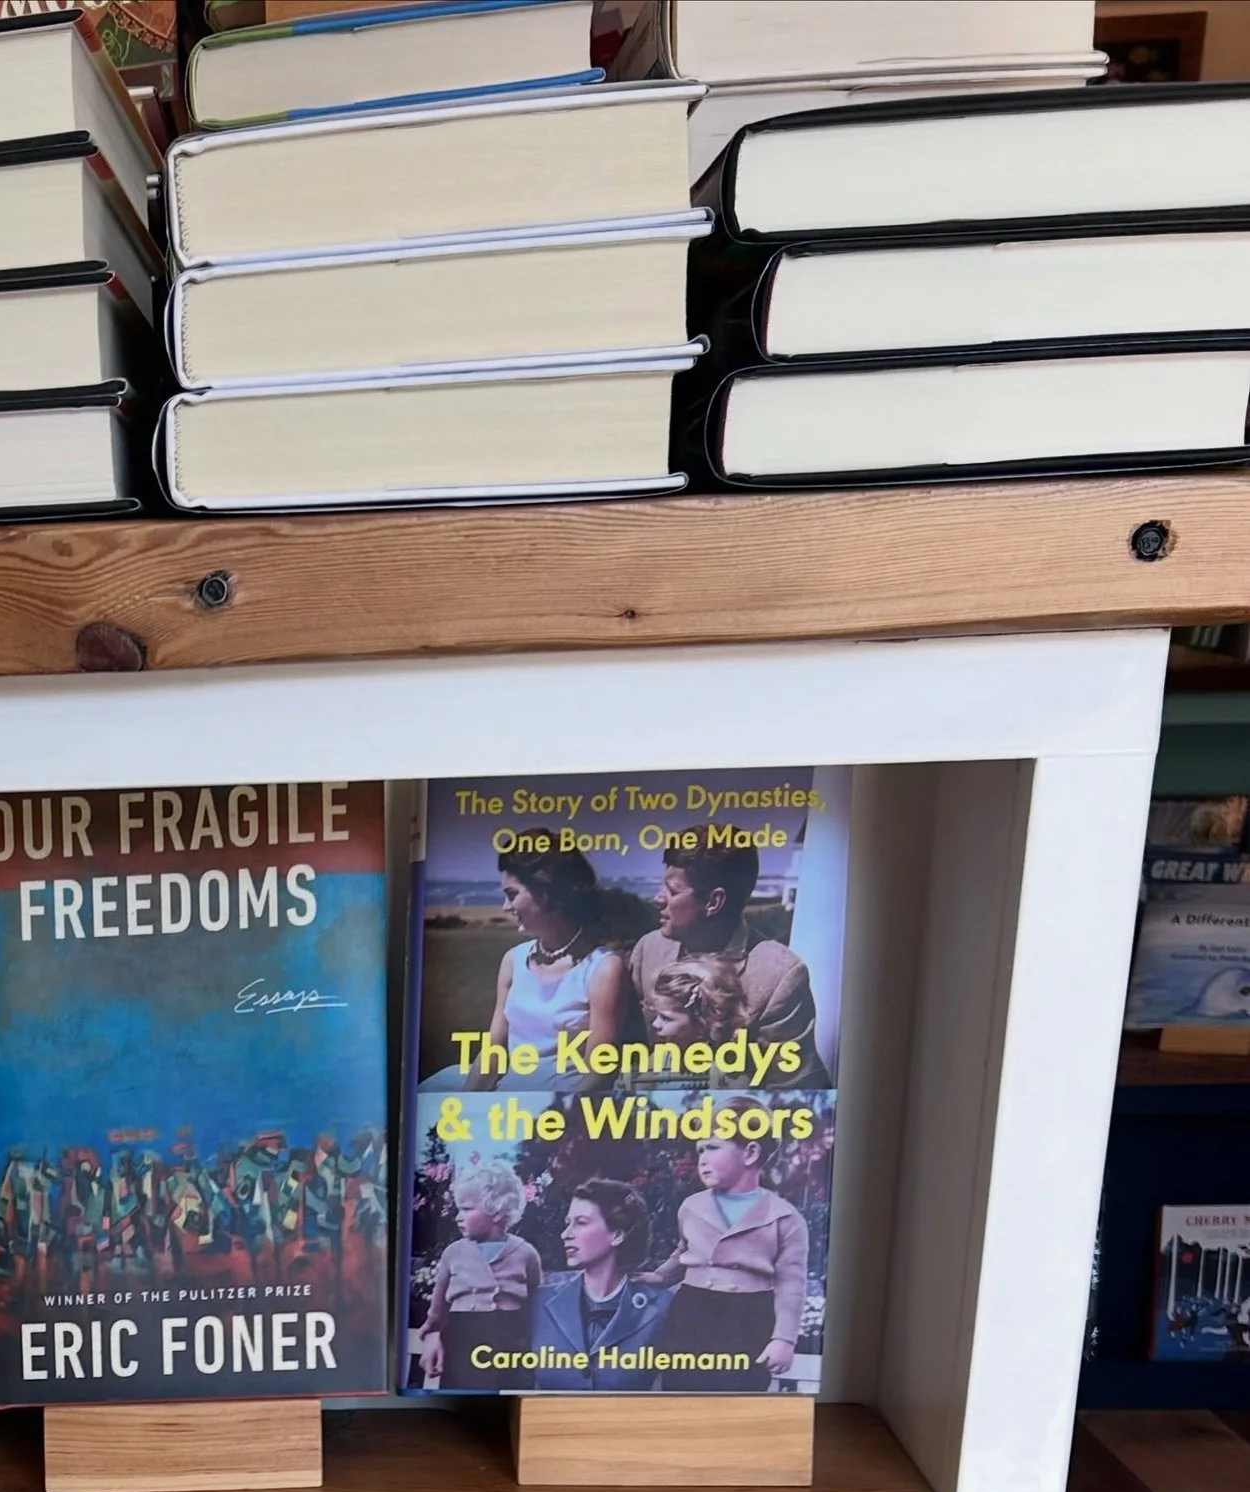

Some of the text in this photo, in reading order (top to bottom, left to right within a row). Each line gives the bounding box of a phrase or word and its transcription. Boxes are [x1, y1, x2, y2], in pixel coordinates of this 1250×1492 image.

[119, 782, 350, 855] FRAGILE
[455, 783, 827, 820] The Story of Two Dynasties,
[492, 823, 788, 856] One Born, One Made
[20, 864, 317, 941] FREEDOMS
[234, 978, 342, 1014] Essays
[452, 1028, 802, 1086] The Kennedys
[436, 1095, 814, 1141] & the Windsors
[44, 1284, 312, 1307] WINNER OF THE PULITZER PRIZE
[21, 1311, 337, 1381] ERIC FONER
[470, 1344, 750, 1372] Caroline Hallemann
